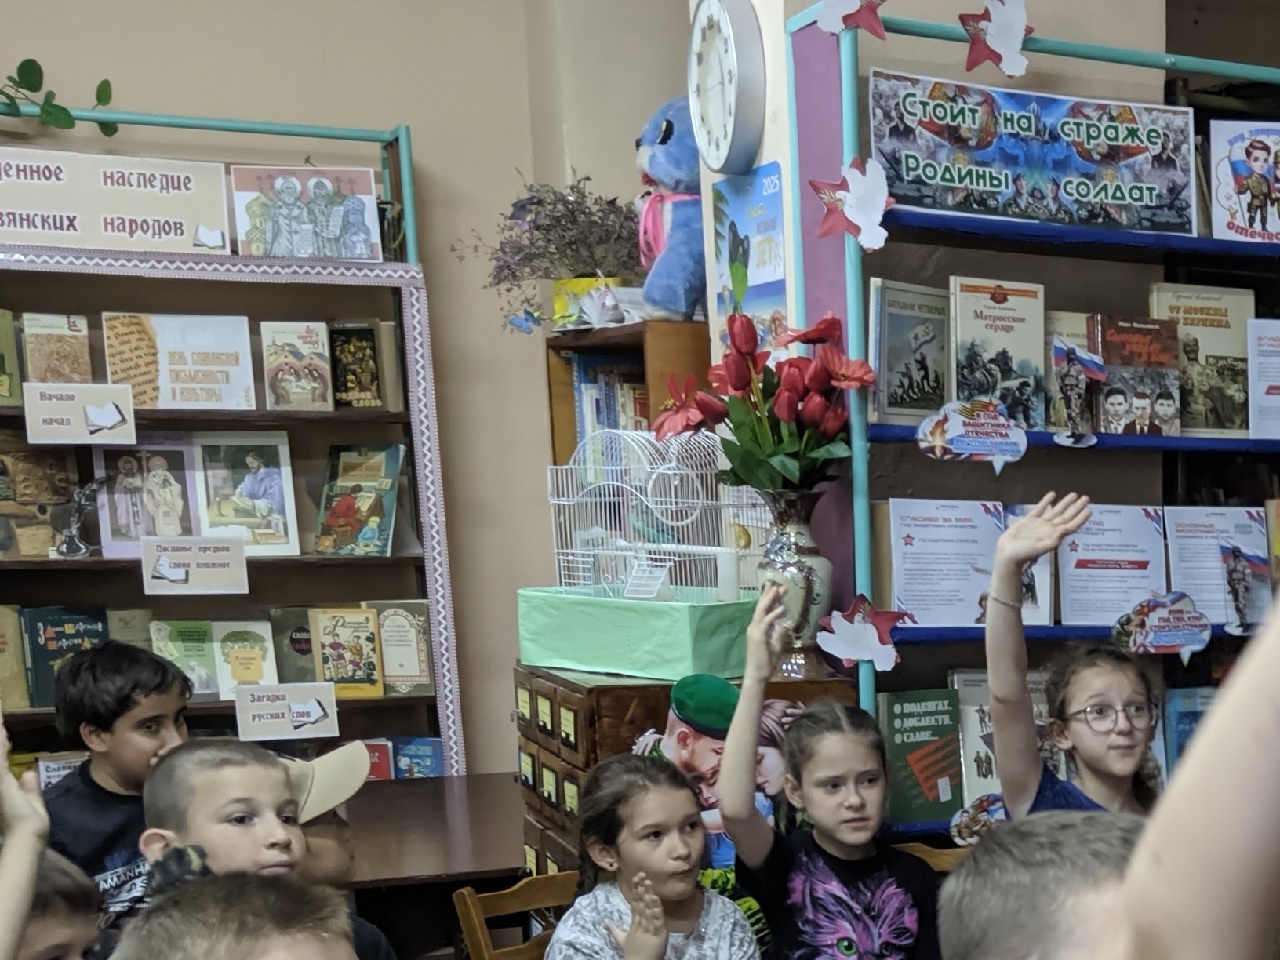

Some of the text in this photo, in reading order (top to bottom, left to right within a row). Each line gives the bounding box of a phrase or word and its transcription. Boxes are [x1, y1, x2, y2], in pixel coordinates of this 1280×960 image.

[901, 92, 1162, 147] Стоит на страже
[0, 161, 193, 195] енное наследие
[904, 153, 1157, 204] Родины солдат
[762, 174, 780, 195] 2025
[103, 216, 185, 239] народов
[973, 309, 1026, 324] Матросское
[985, 322, 1015, 334] сердце
[39, 391, 76, 402] Начало
[41, 417, 72, 427] начал
[249, 692, 287, 704] Загадки
[893, 703, 902, 715] О
[251, 710, 312, 723] русских слов
[893, 717, 902, 729] О
[894, 733, 903, 745] О
